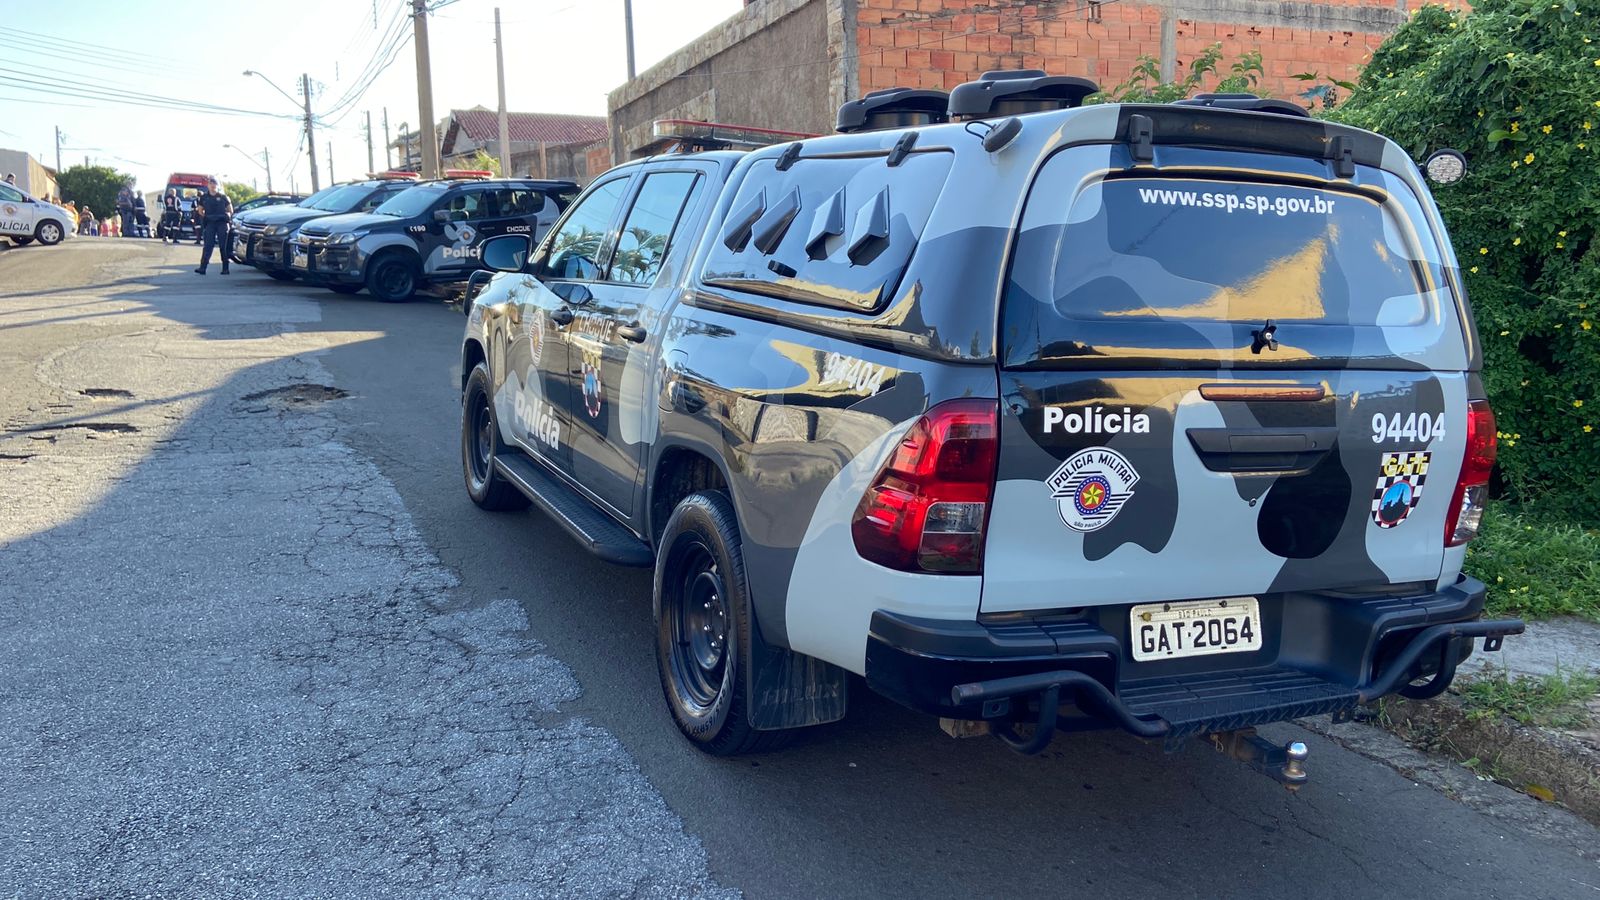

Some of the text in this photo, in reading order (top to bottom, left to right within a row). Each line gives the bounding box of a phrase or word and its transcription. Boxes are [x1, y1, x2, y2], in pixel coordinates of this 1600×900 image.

[1139, 188, 1335, 217] www.ssp.sp.gov.br
[0, 220, 30, 231] LÍCIA
[443, 246, 481, 259] Políci
[514, 390, 560, 451] Polícia
[1043, 406, 1150, 434] Polícia
[1371, 412, 1446, 443] 94404
[1053, 452, 1132, 488] POLÍCIA MILITAR
